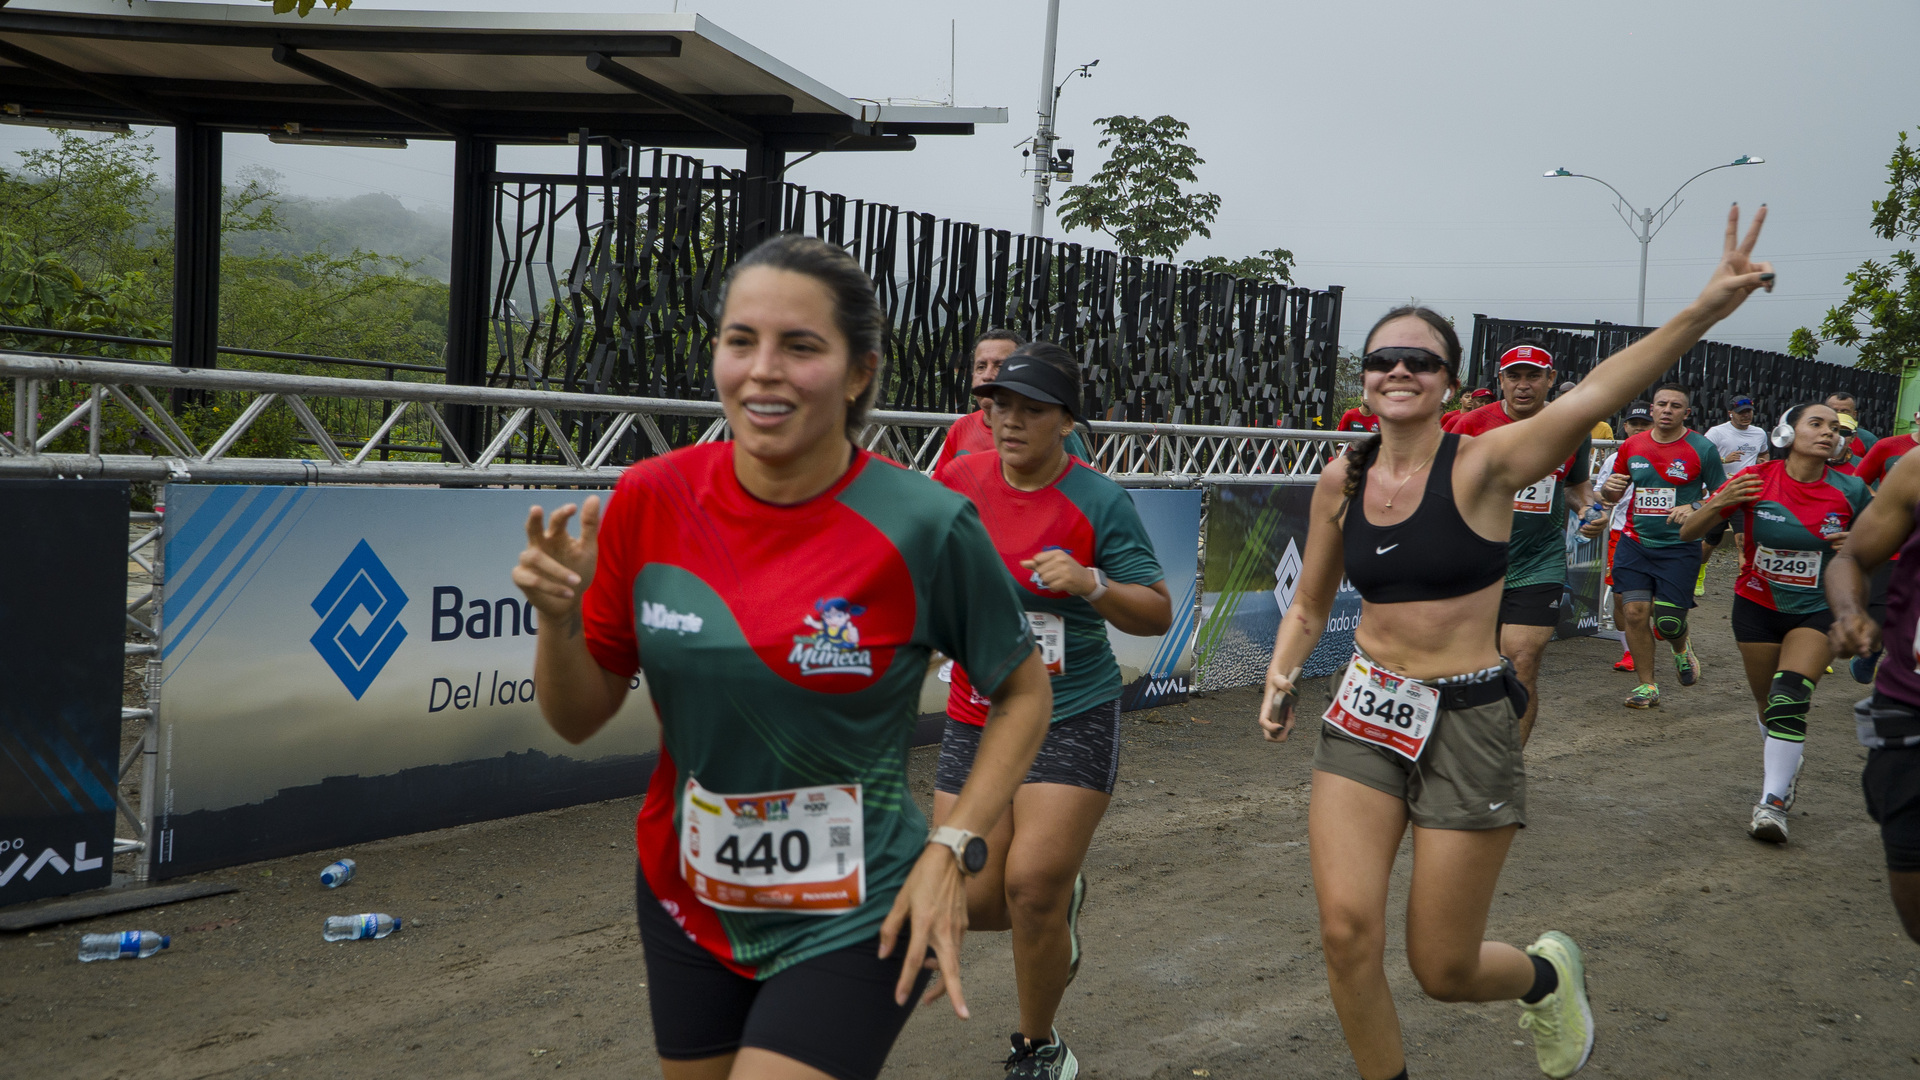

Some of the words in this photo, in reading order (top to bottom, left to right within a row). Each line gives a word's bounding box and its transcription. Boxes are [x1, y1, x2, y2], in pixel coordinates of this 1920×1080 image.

[1638, 496, 1667, 507] 1893
[1763, 558, 1807, 574] 1249
[788, 643, 872, 672] Muñeca
[428, 672, 481, 713] Del
[1145, 677, 1187, 697] AVAL
[1352, 684, 1414, 729] 1348
[715, 829, 810, 875] 440
